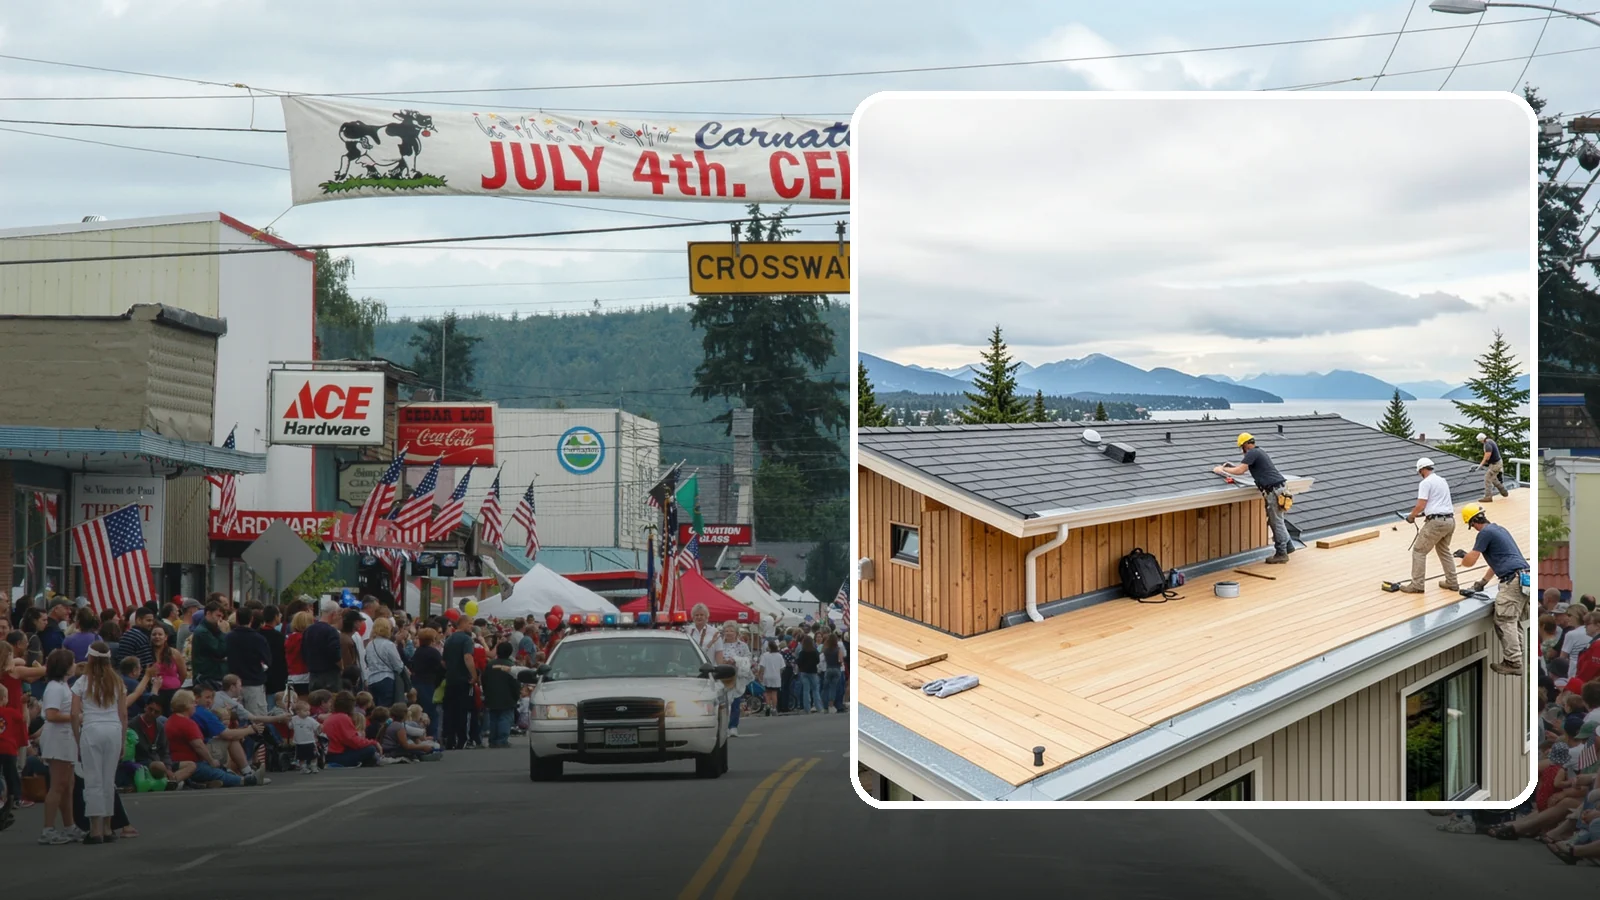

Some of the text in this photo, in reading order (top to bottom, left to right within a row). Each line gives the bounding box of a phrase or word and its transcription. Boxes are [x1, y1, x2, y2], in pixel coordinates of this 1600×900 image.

[481, 141, 604, 193] JULY
[632, 150, 746, 197] 4th.
[697, 254, 850, 280] CROSSWA
[283, 380, 373, 420] ACE
[406, 409, 452, 422] CEDAR
[283, 421, 371, 436] Hardware
[353, 467, 386, 480] Simpl
[95, 485, 124, 495] Vincent
[126, 486, 136, 495] de
[137, 486, 155, 495] Paul
[699, 535, 730, 543] GLASS
